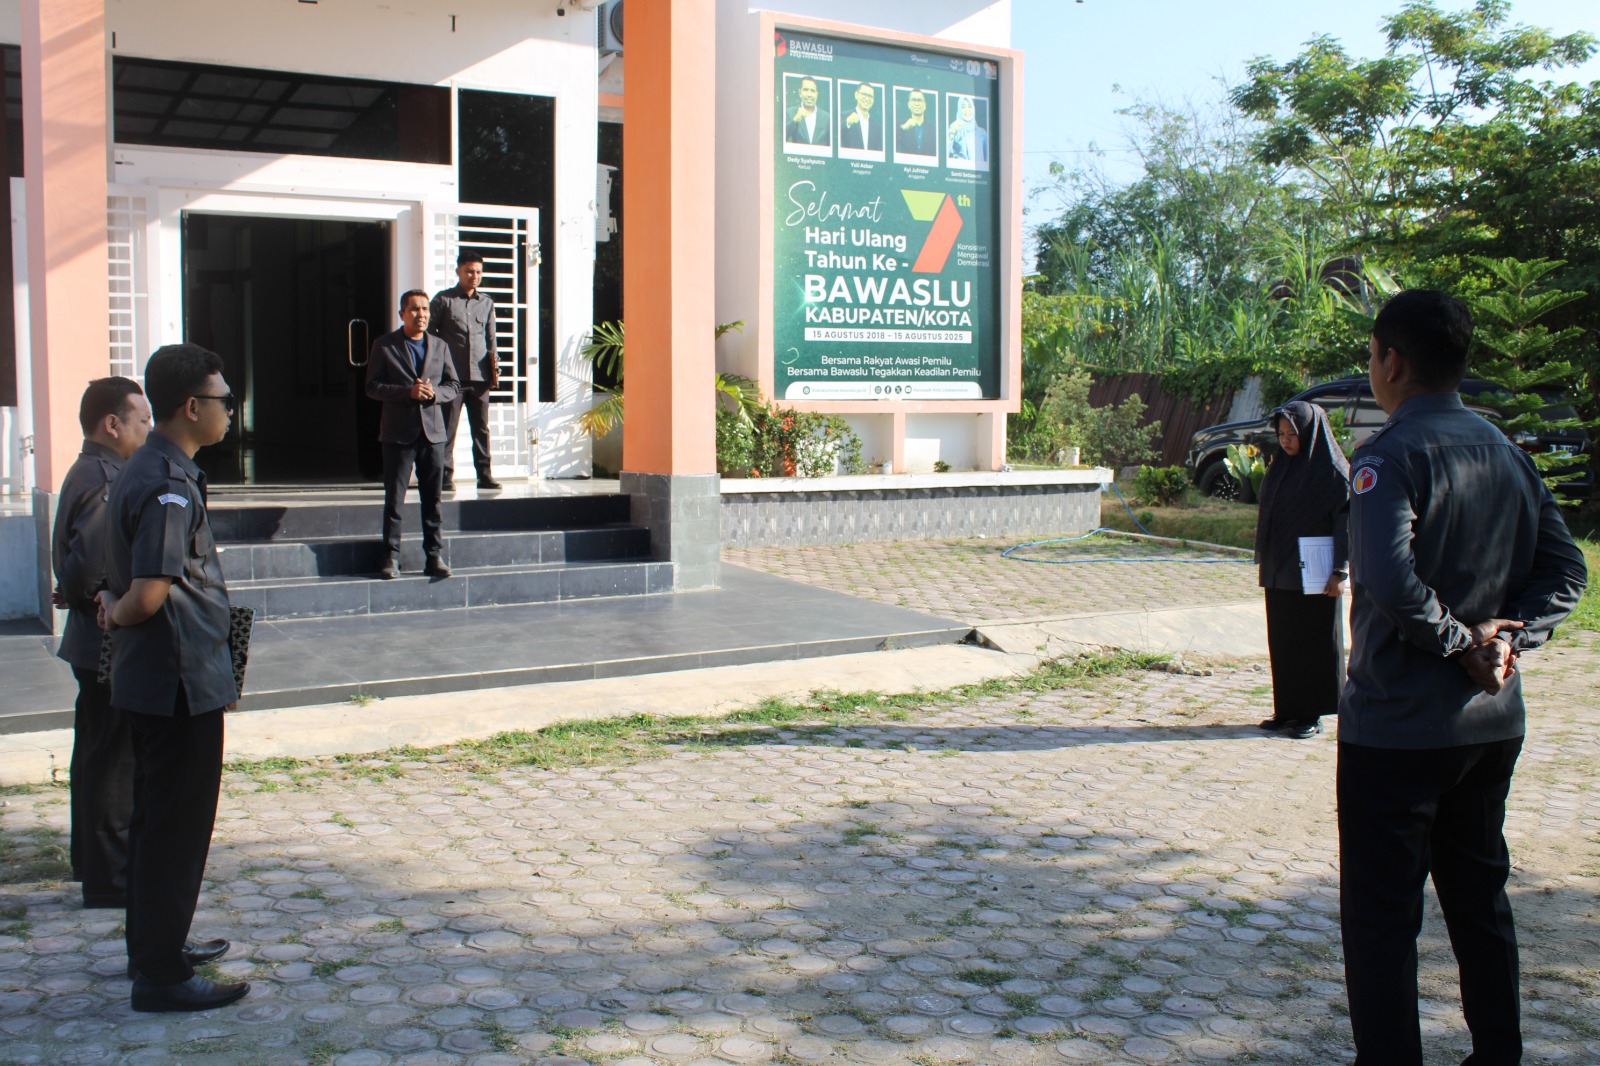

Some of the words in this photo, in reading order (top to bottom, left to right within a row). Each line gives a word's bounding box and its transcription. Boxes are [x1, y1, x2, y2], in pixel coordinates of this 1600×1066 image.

[790, 40, 833, 54] BAWASLU
[785, 180, 887, 226] Selamat
[805, 226, 845, 246] Hari
[852, 229, 907, 253] Ulang
[804, 250, 866, 270] Tahun
[873, 254, 897, 271] Ke
[804, 274, 971, 307] BAWASLU
[805, 307, 972, 327] KABUPATEN/KOTA
[813, 331, 822, 339] 15
[824, 331, 864, 340] AGUSTUS
[866, 331, 885, 340] 2018
[894, 332, 903, 340] 15
[905, 332, 942, 341] AGUSTUS
[944, 333, 964, 341] 2025
[821, 355, 862, 365] Bersama
[863, 356, 893, 367] Rakyat
[894, 356, 921, 366] Awasi
[922, 356, 952, 366] Pemilu
[787, 367, 828, 376] Bersama
[830, 367, 868, 376] Bawaslu
[870, 367, 912, 378] Tegakkan
[914, 367, 950, 376] Keadilan
[952, 367, 982, 377] Pemilu
